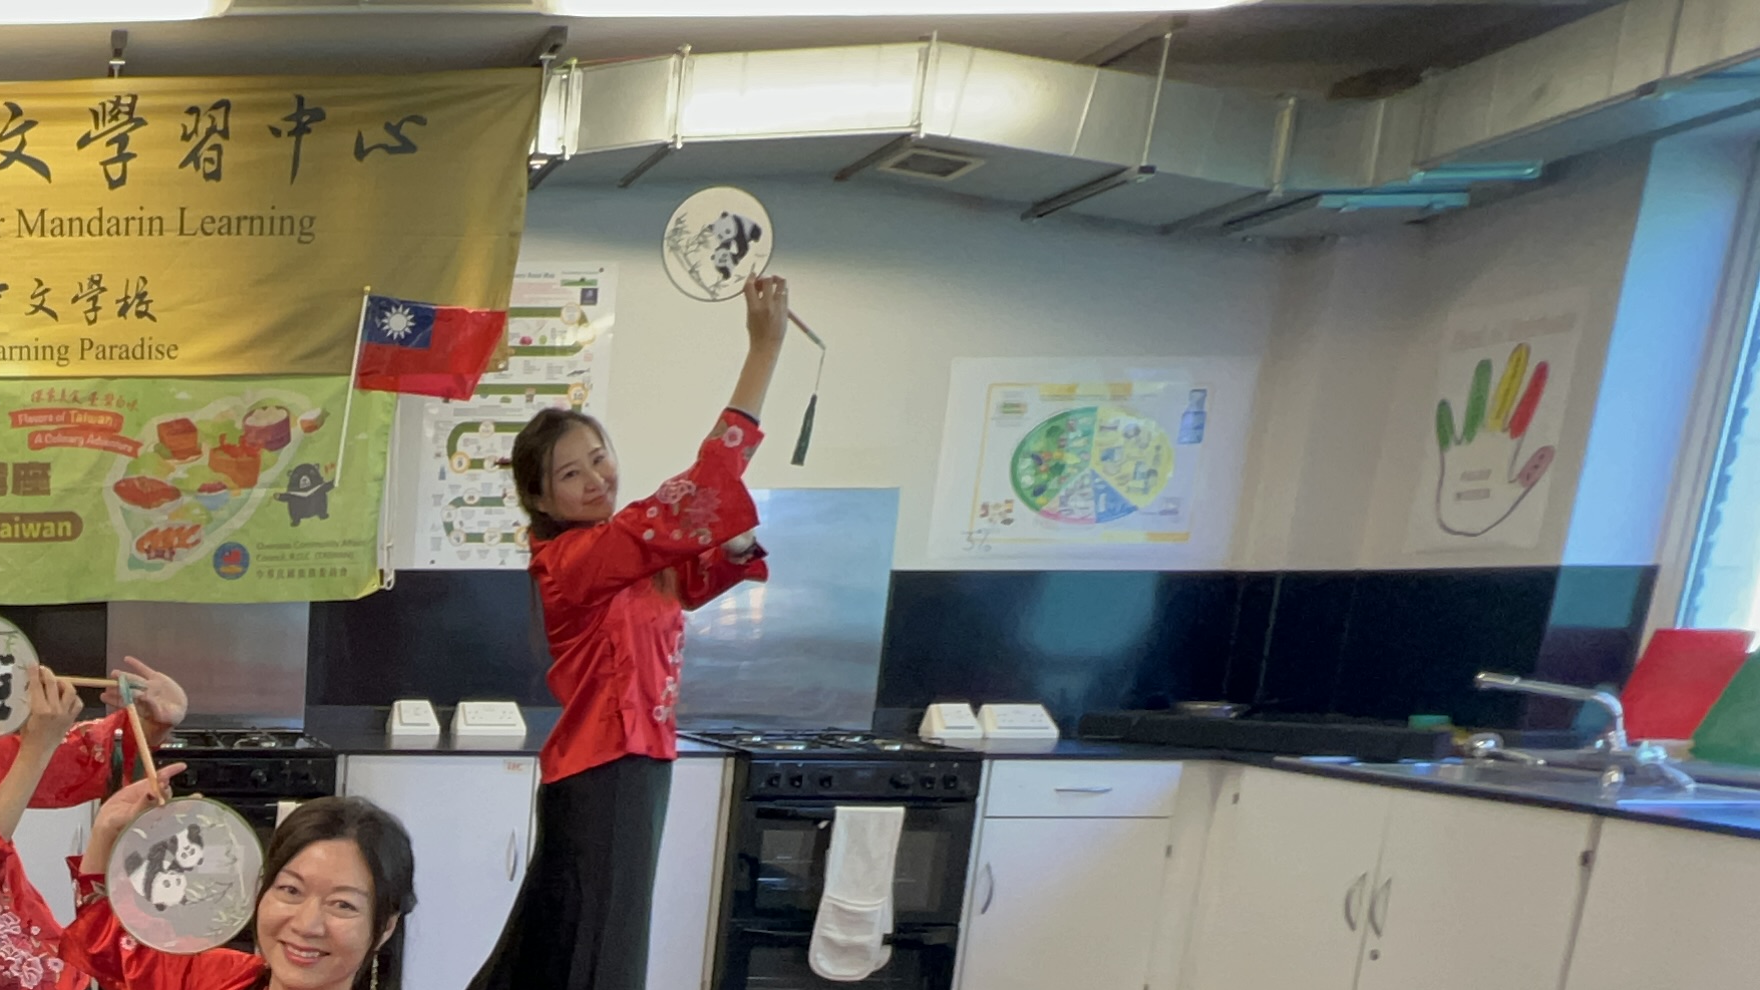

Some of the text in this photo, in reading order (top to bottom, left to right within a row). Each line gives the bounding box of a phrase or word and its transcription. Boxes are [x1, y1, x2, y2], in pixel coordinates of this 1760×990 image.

[16, 206, 165, 240] Mandarin
[177, 205, 317, 244] Learning
[78, 336, 179, 361] Paradise
[68, 409, 114, 426] Taiwan
[34, 432, 43, 444] A
